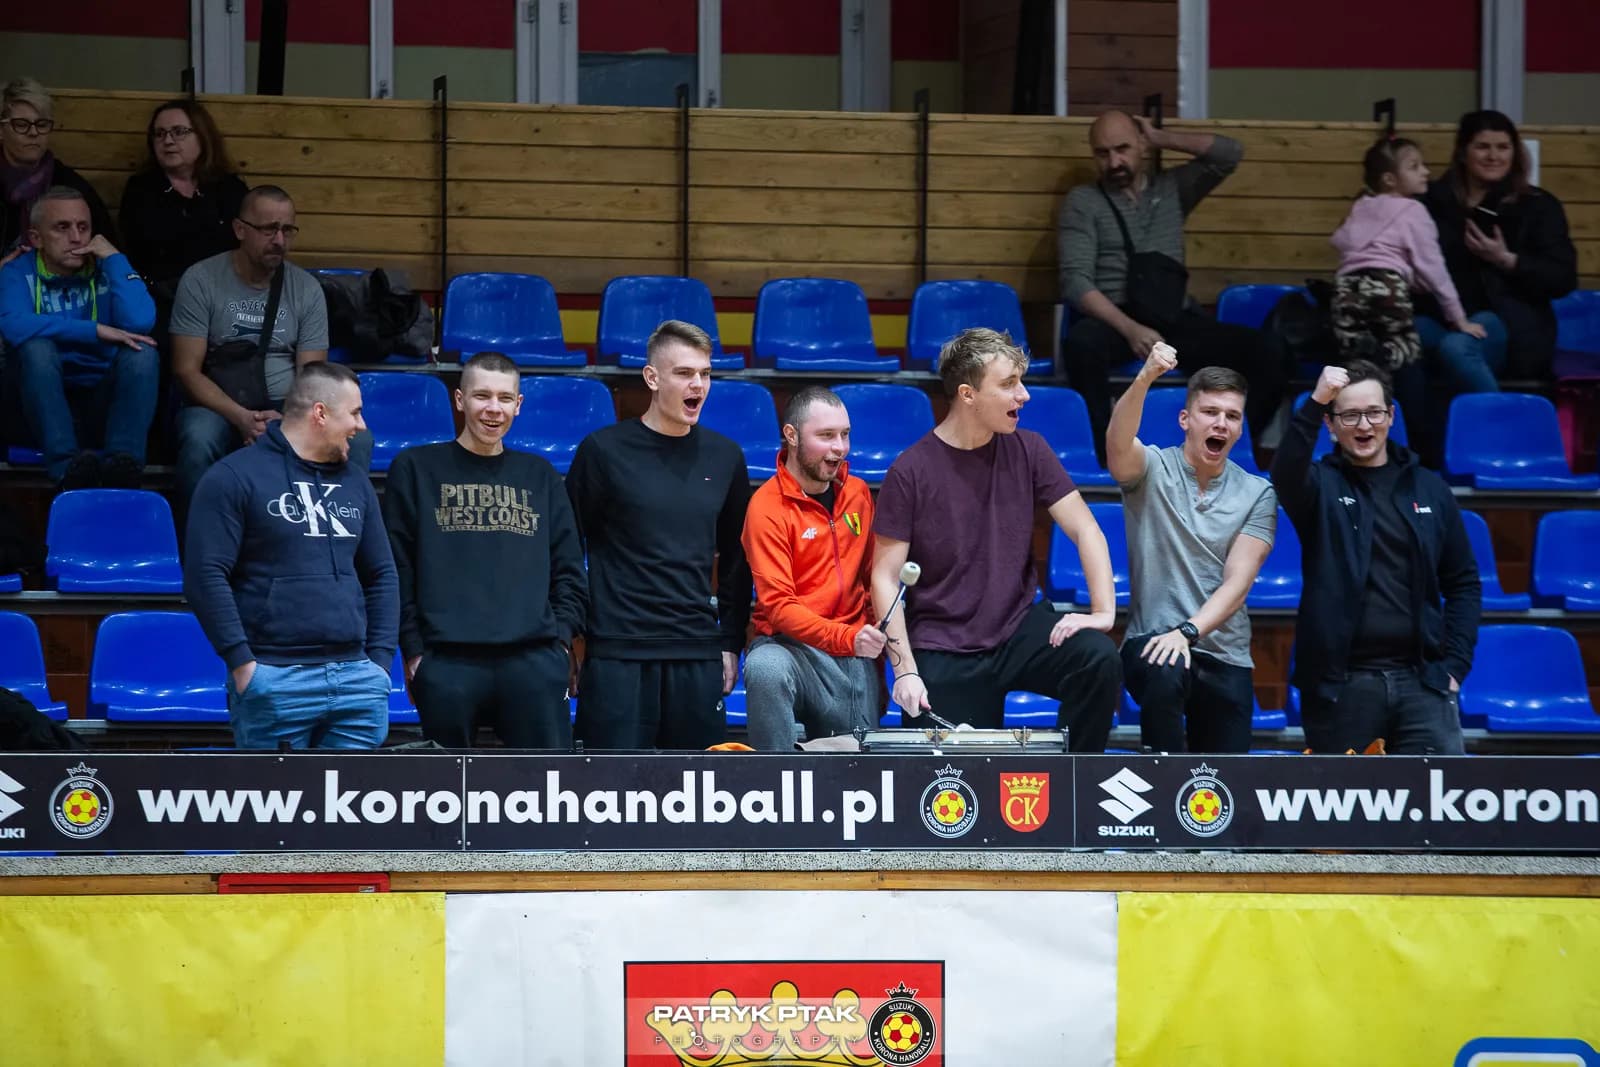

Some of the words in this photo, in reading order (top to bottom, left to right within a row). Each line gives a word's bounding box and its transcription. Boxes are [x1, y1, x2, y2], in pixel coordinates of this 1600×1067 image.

[228, 300, 287, 319] SLAZENR
[441, 483, 533, 512] PITBULL
[435, 506, 485, 526] WEST
[488, 507, 540, 531] COAST
[801, 527, 818, 540] 4F
[937, 781, 961, 791] SUZUKI
[137, 770, 894, 840] www.koronahandball.pl
[1005, 796, 1040, 825] CK
[925, 811, 947, 833] KORONA
[946, 811, 973, 833] HANDBALL
[1097, 825, 1155, 837] SUZUKI
